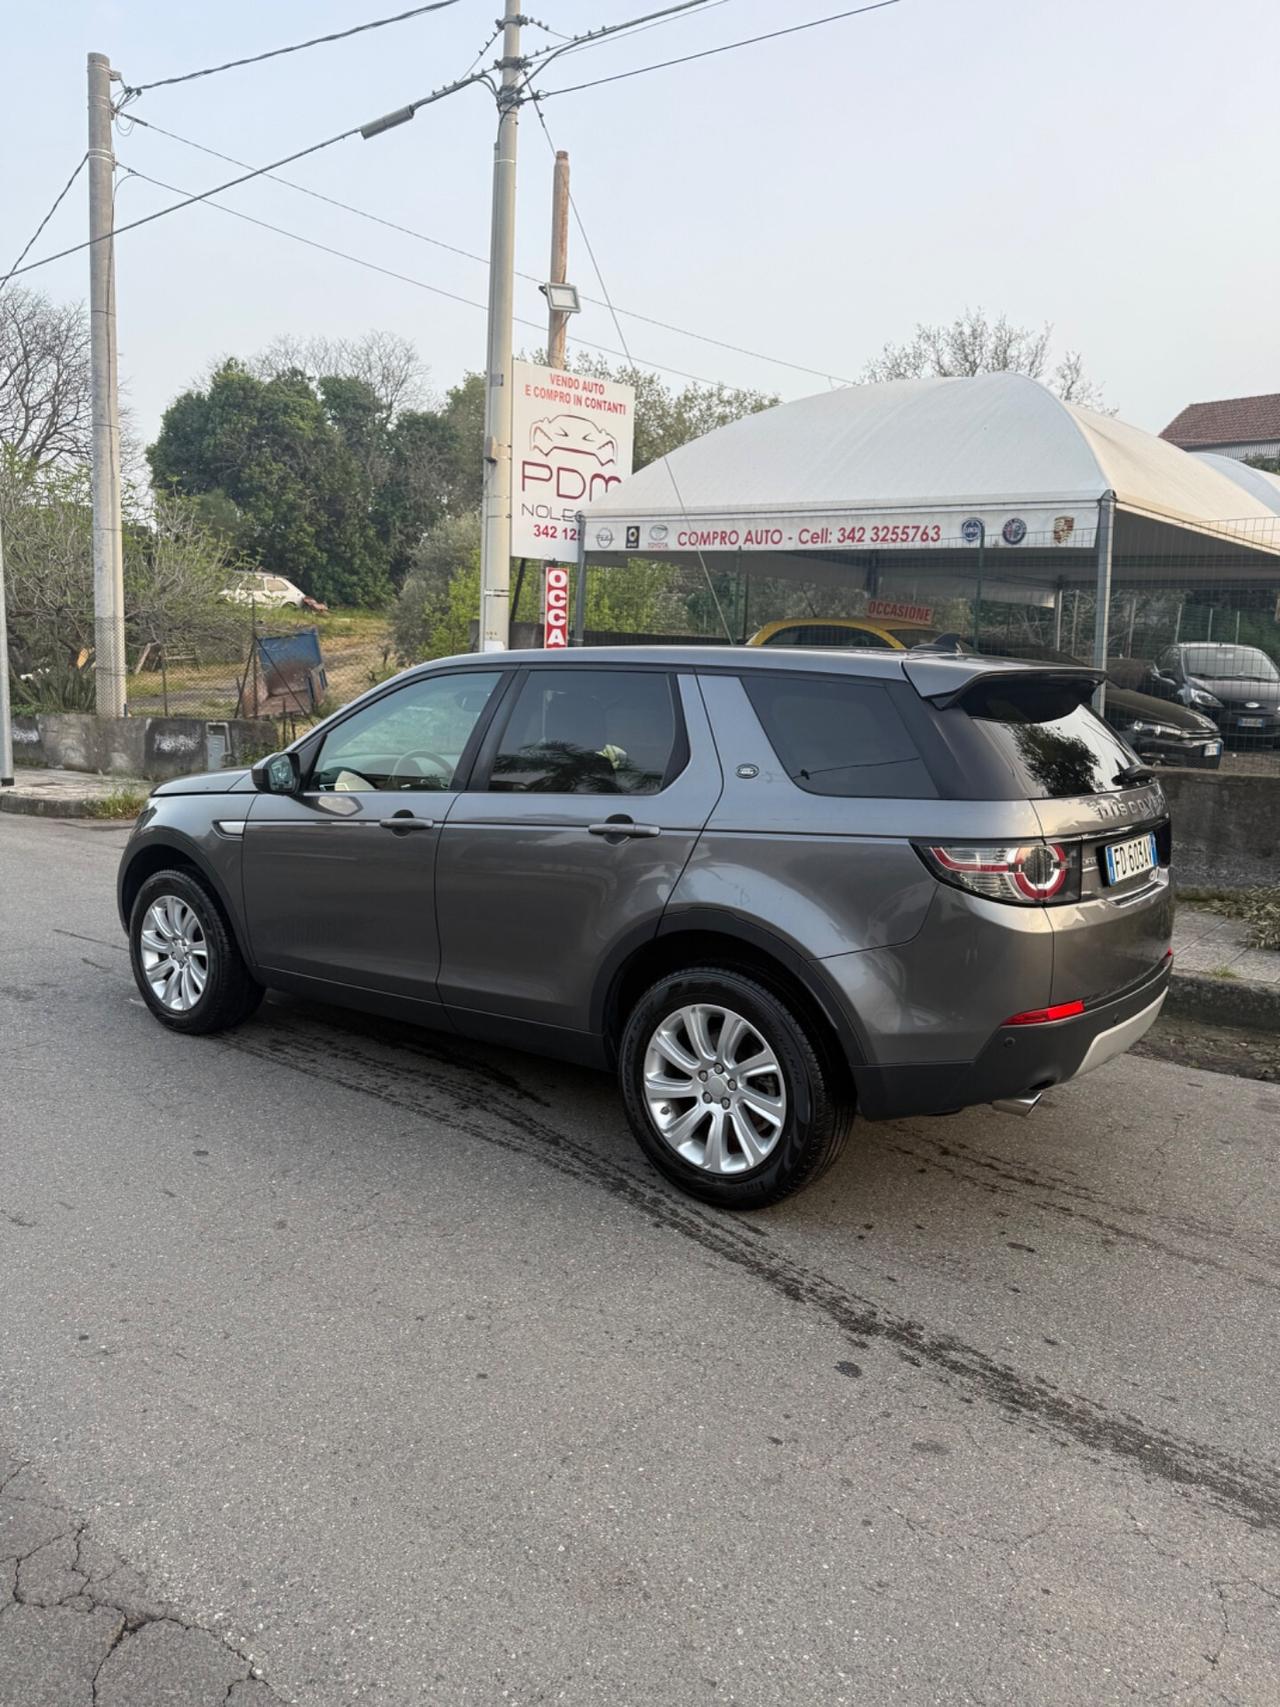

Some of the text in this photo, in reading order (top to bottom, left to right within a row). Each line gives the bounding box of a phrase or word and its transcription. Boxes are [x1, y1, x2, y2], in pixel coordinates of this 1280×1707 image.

[550, 373, 605, 395] VENDO AUTO
[525, 384, 626, 414] E COMPRO IN CONTANTI
[534, 524, 580, 541] 342 12
[677, 530, 740, 546] COMPRO
[743, 529, 783, 545] AUTO
[798, 527, 832, 544] Cell:
[837, 526, 866, 543] 342
[870, 525, 941, 542] 3255763
[547, 570, 567, 645] OCCA
[868, 601, 931, 621] OCCASIONE
